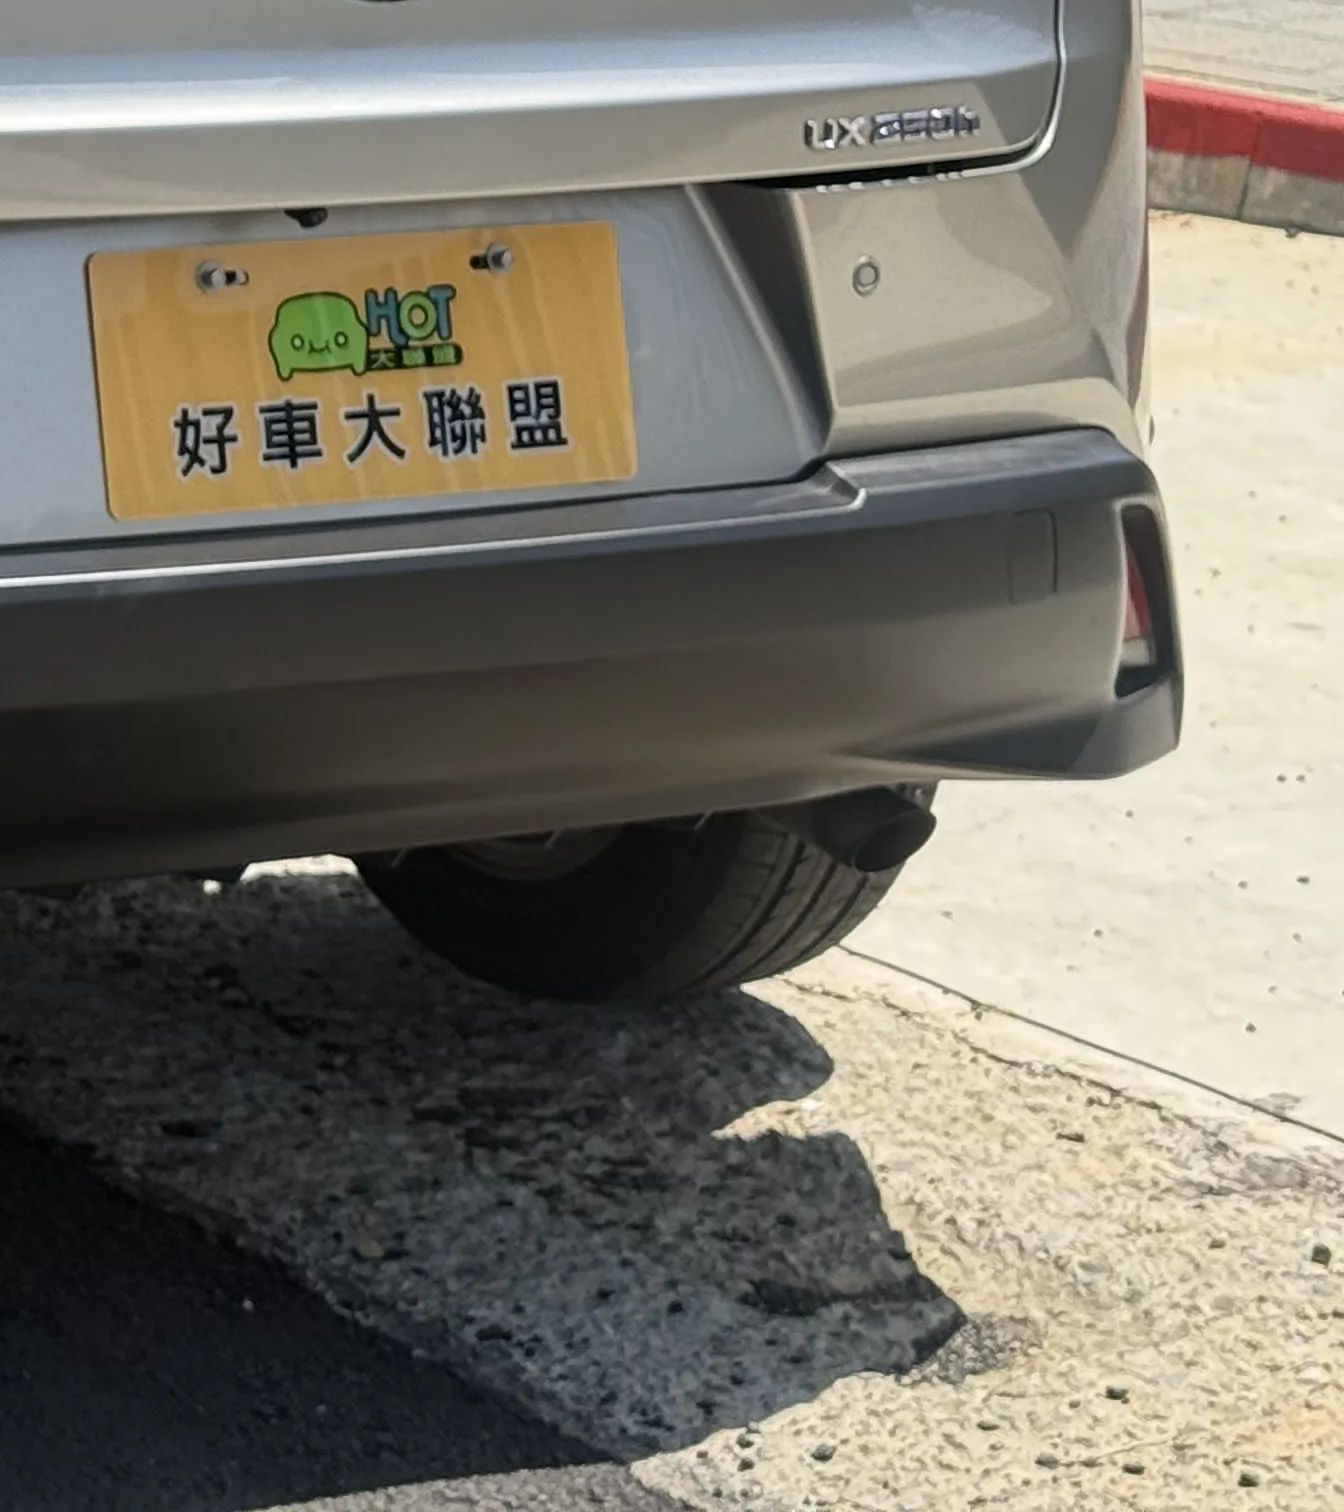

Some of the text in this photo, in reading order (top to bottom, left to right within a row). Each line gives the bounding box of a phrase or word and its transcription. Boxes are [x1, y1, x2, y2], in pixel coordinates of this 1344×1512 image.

[365, 284, 457, 347] HOT
[174, 380, 569, 478] 好車大聯盟
